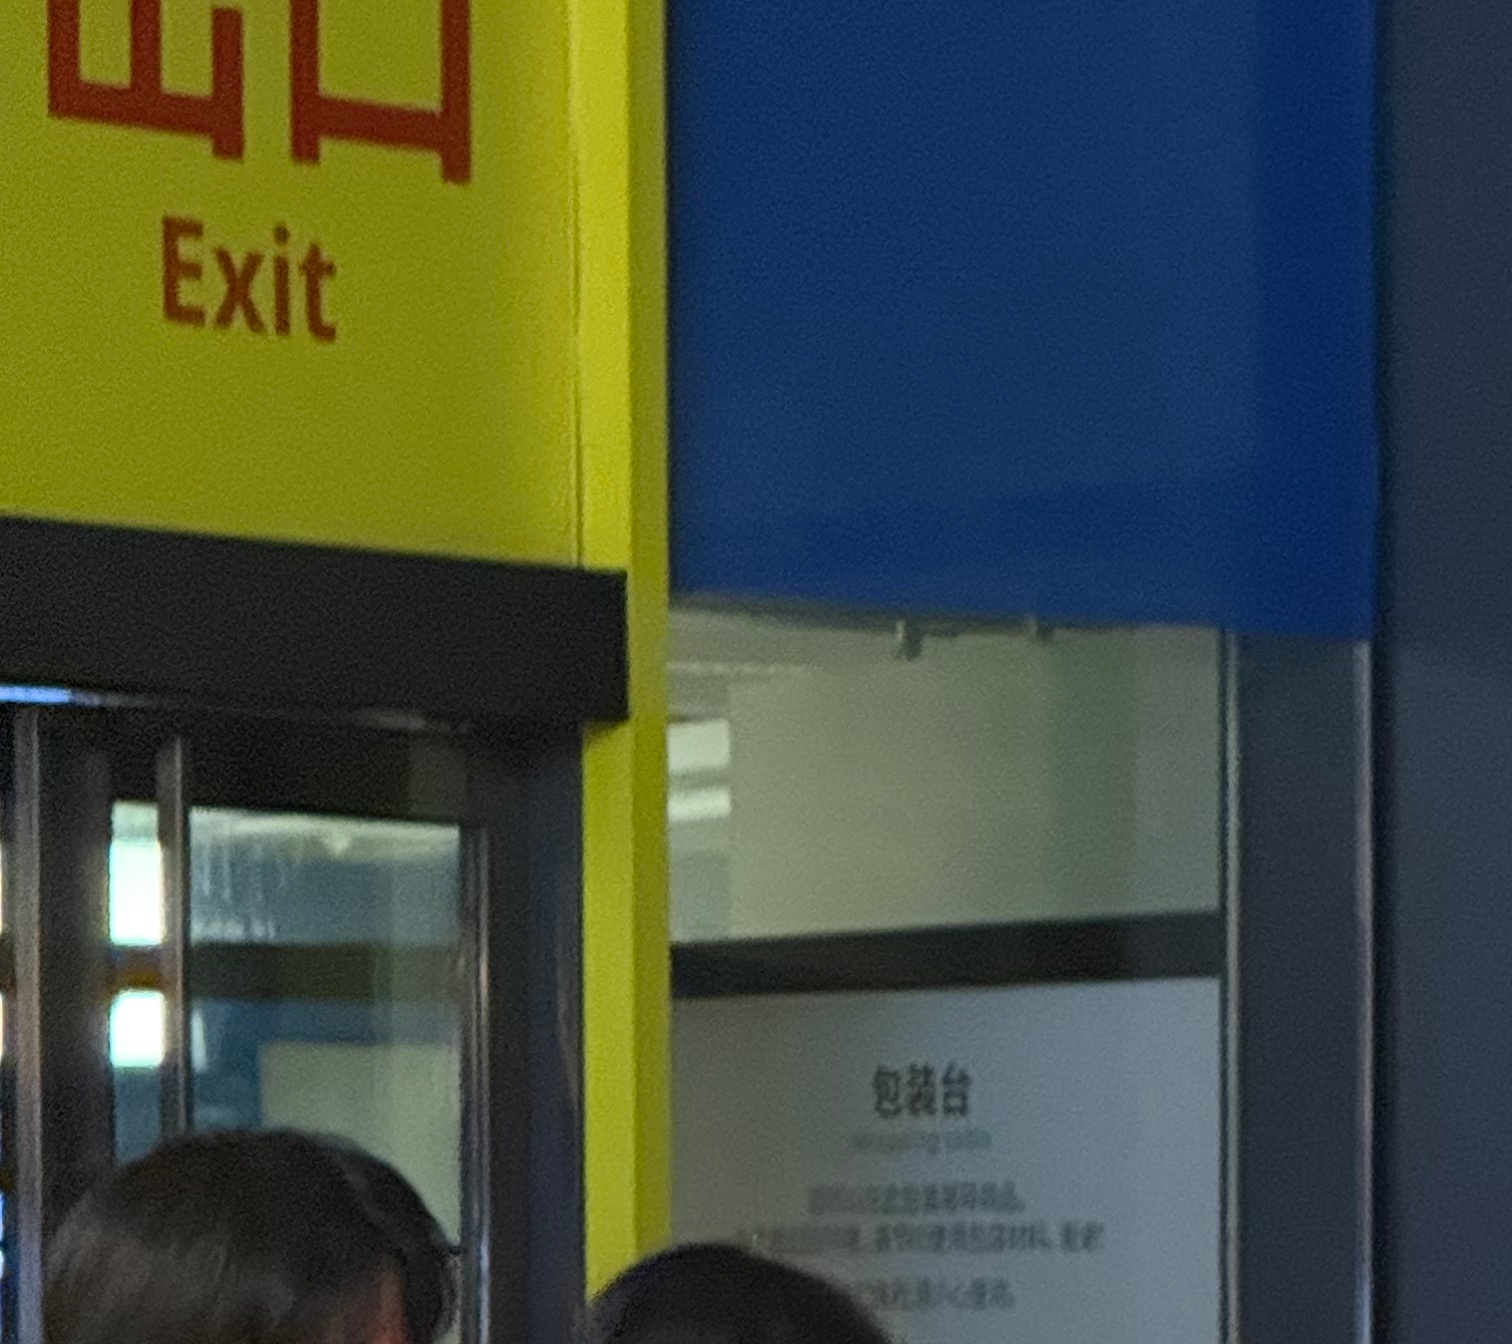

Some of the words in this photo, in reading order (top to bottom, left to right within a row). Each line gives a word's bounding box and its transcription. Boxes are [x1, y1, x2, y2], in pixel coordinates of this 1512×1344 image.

[161, 215, 337, 342] Exit
[872, 1060, 973, 1118] 包装台
